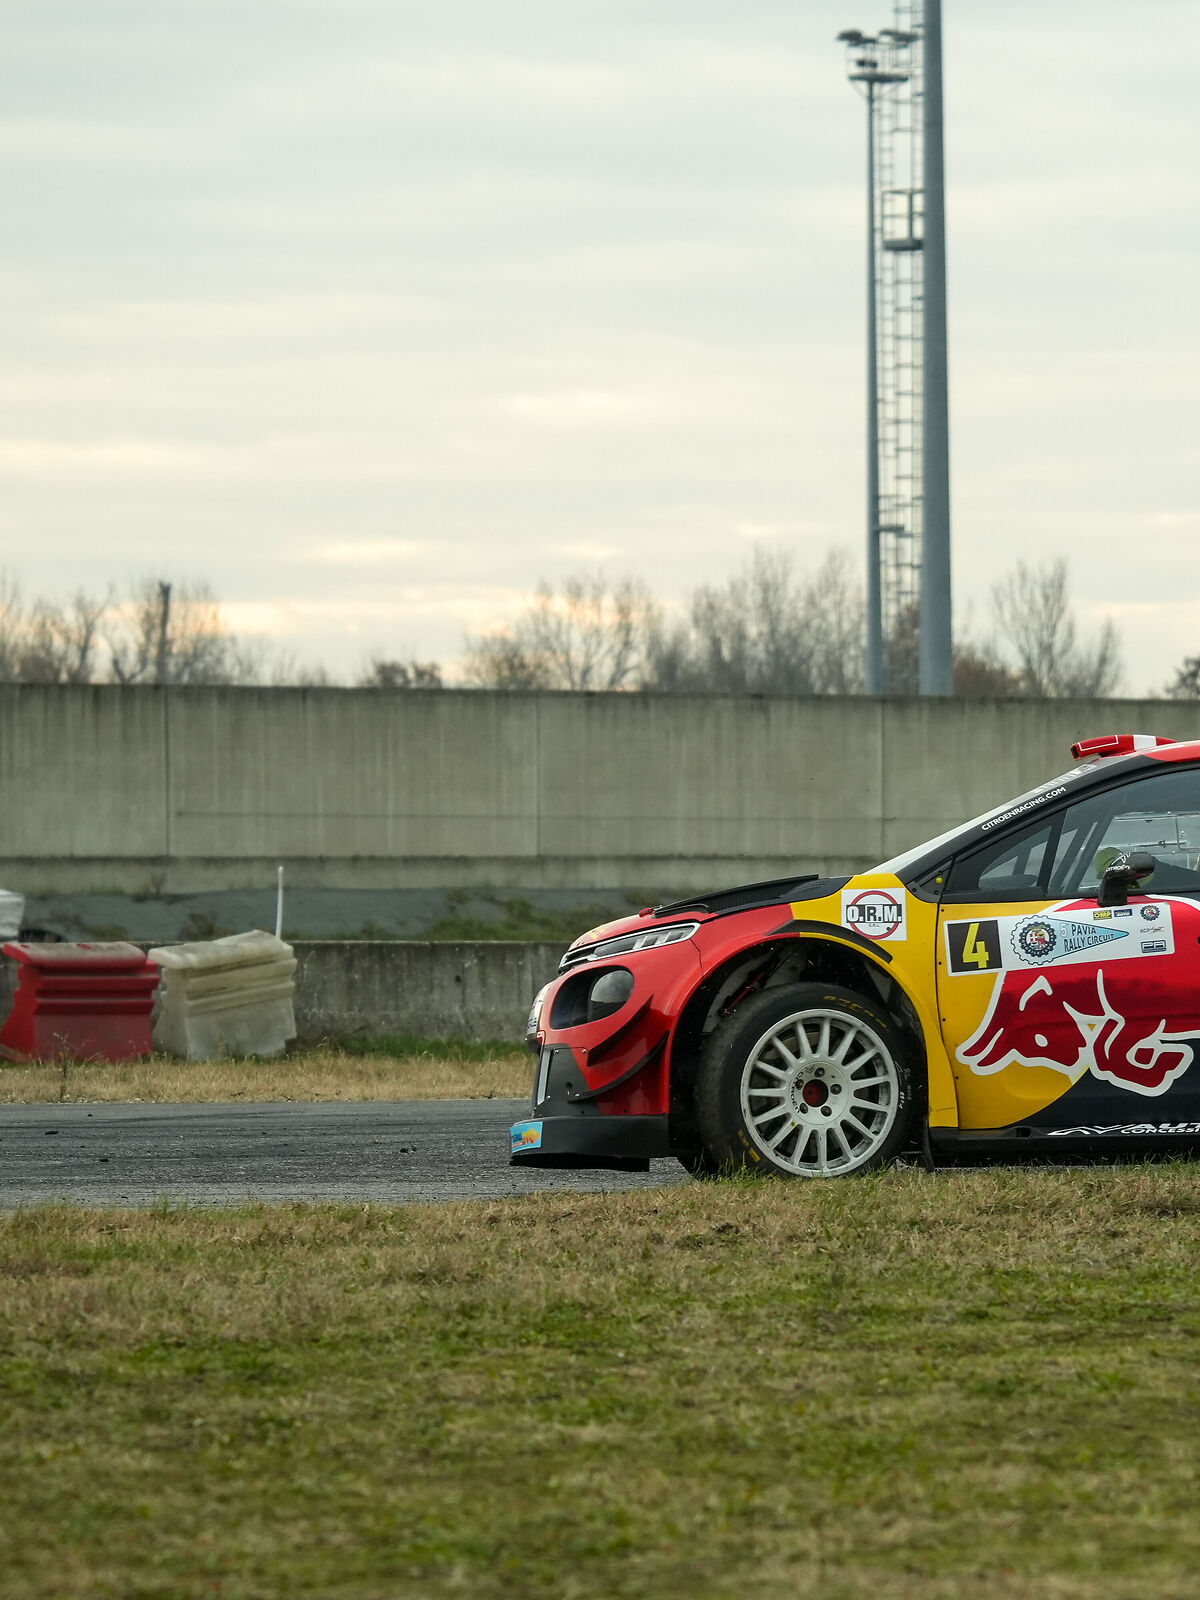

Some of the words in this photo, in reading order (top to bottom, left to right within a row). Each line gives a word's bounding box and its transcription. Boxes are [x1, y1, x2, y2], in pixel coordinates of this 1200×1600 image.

[981, 786, 1066, 831] CITROENRACING.COM
[847, 905, 902, 922] O.R.M.
[1071, 924, 1096, 936] PAVIA
[962, 922, 989, 968] 4
[1064, 937, 1085, 953] RALLY
[1087, 934, 1115, 945] CIRCUIT
